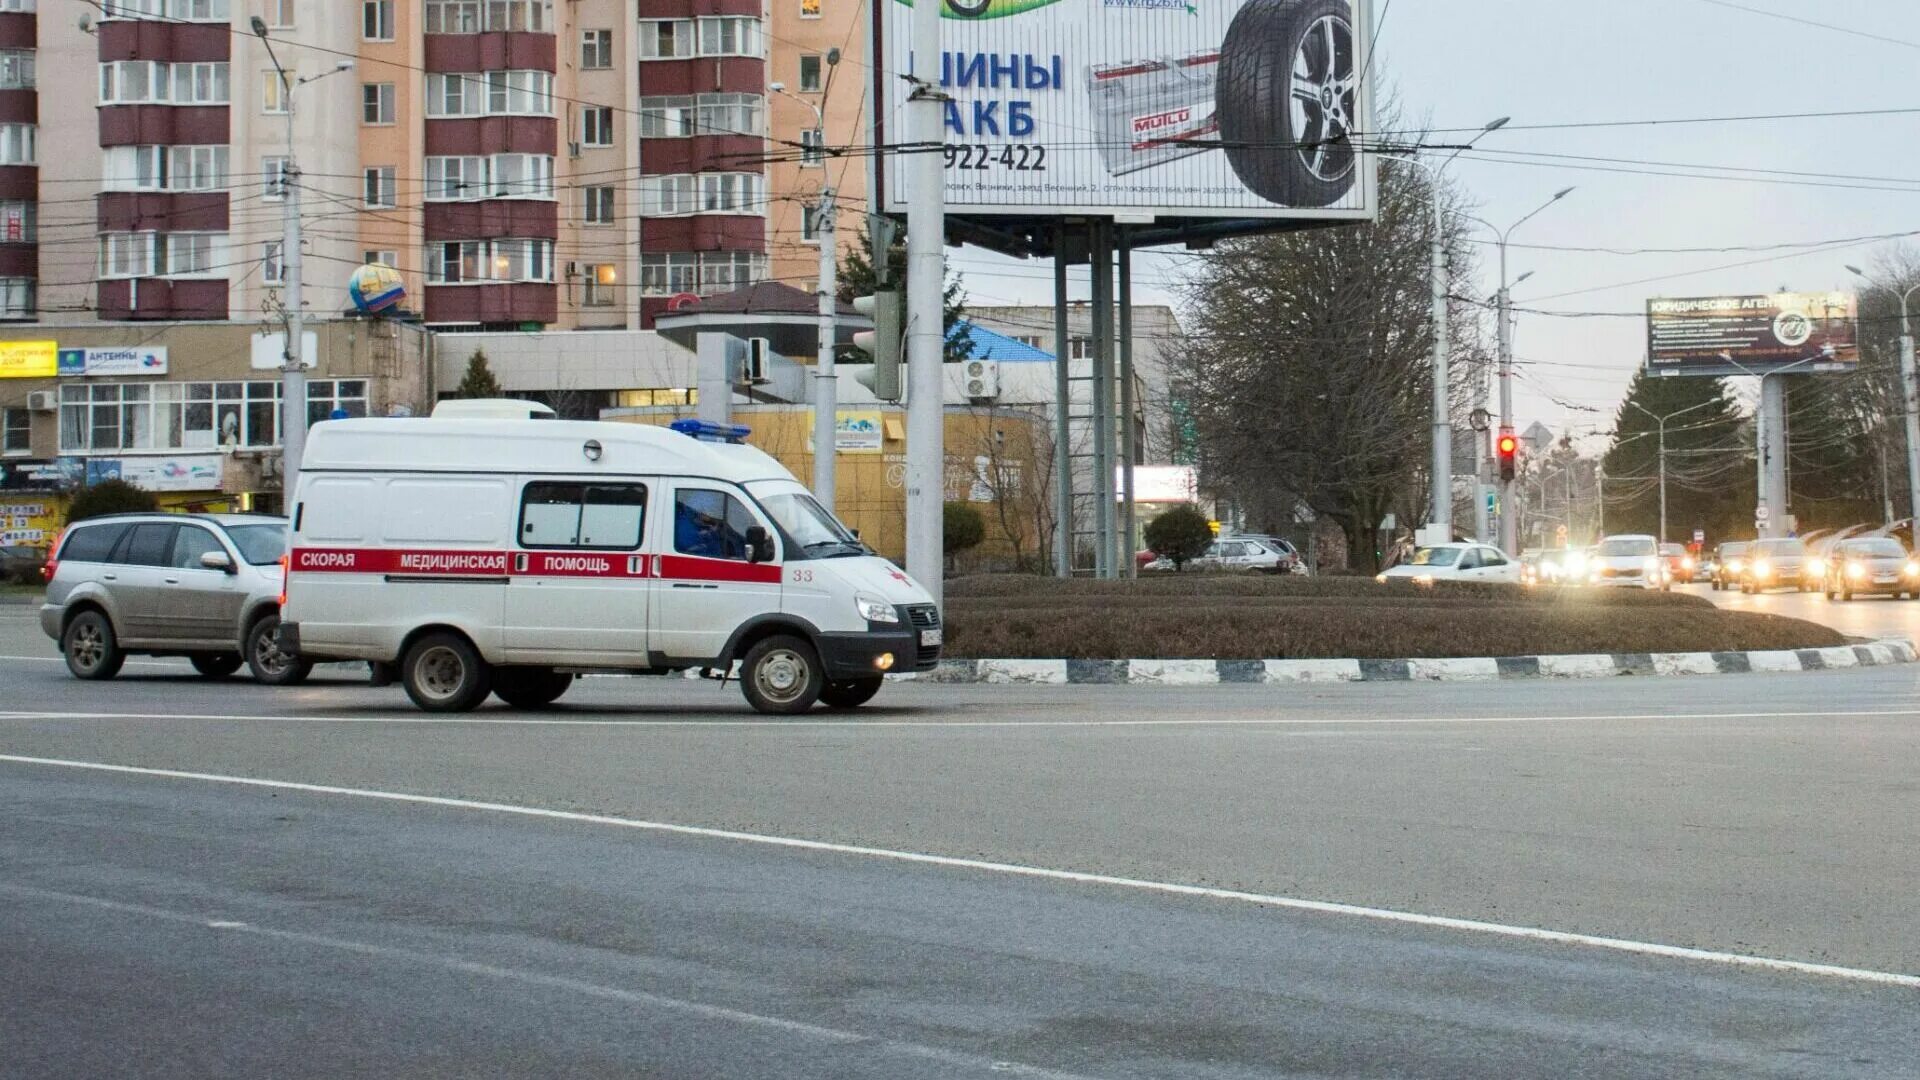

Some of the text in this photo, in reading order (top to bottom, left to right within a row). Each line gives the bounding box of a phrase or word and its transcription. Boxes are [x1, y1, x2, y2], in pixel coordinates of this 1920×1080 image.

[943, 99, 1035, 137] АКБ
[1134, 109, 1190, 133] MUTLU
[944, 144, 1046, 171] 922-422
[1651, 298, 1740, 313] ЮРИДИЧЕСКОЕ
[89, 351, 137, 361] АНТЕННЫ
[301, 552, 610, 573] СКОРАЯ МЕДИЦИНСКАЯ ПОМОЩЬ
[792, 569, 813, 582] 33
